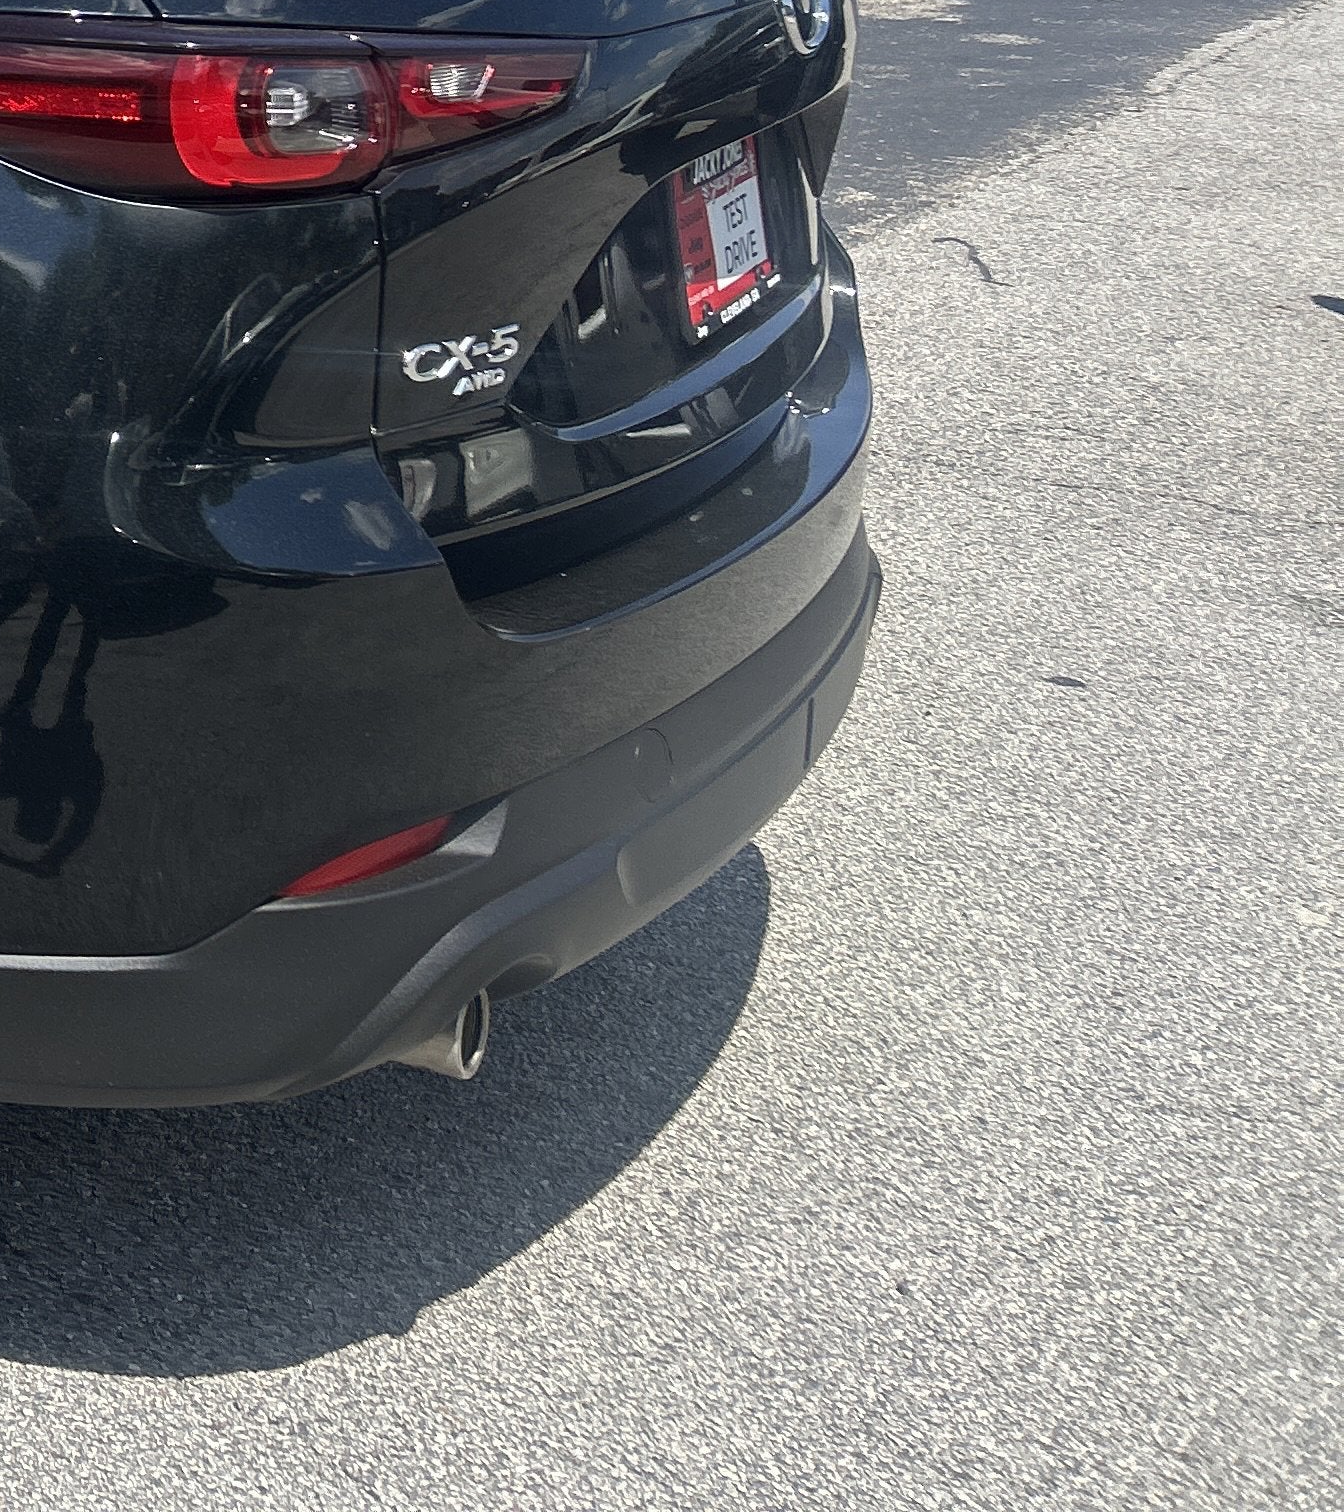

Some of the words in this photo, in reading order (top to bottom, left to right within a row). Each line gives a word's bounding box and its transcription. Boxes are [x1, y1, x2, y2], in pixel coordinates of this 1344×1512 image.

[723, 192, 748, 233] TEST
[724, 229, 759, 275] DRIVE
[402, 323, 520, 383] CX-5
[452, 368, 506, 396] AWD
